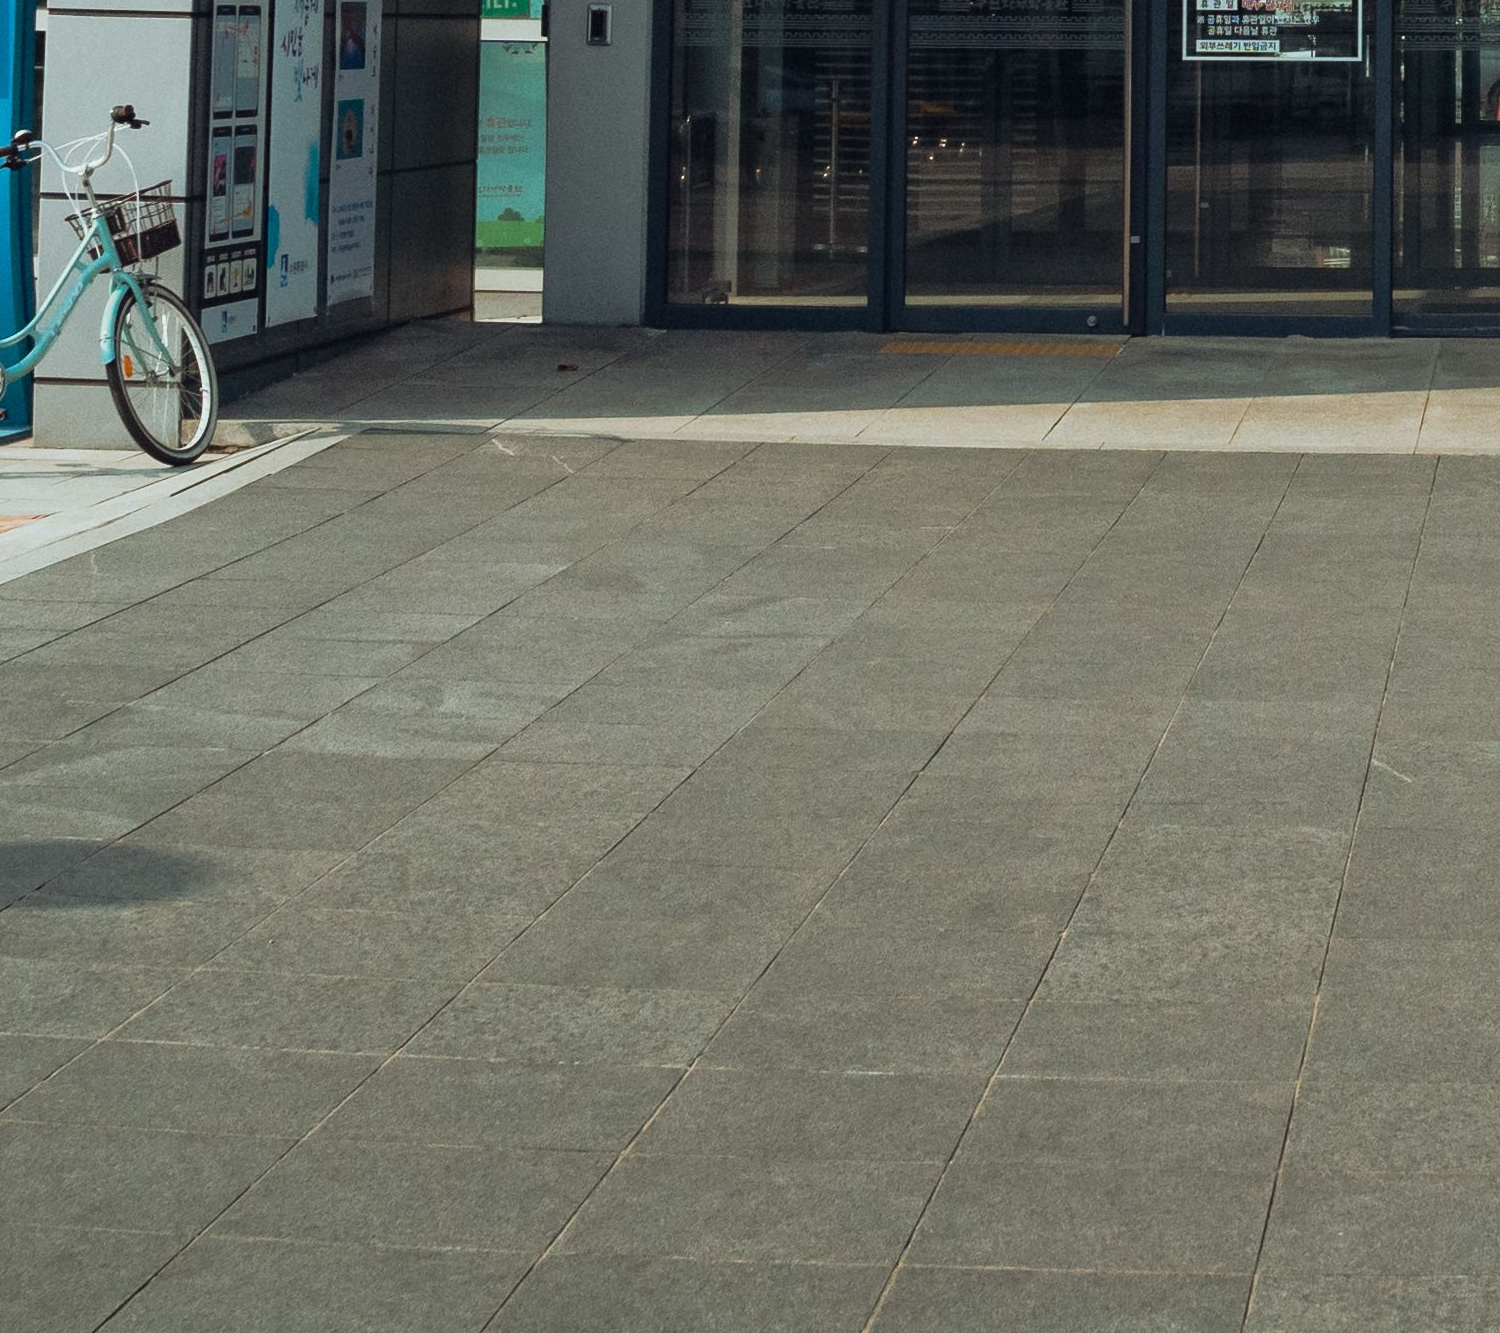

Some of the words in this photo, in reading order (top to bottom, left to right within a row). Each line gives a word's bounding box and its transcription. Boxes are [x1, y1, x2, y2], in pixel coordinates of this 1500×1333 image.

[1207, 26, 1232, 36] 공휴일
[1234, 26, 1259, 36] 다음날
[1200, 41, 1242, 51] 외부쓰레기
[1243, 41, 1276, 51] 반입금지
